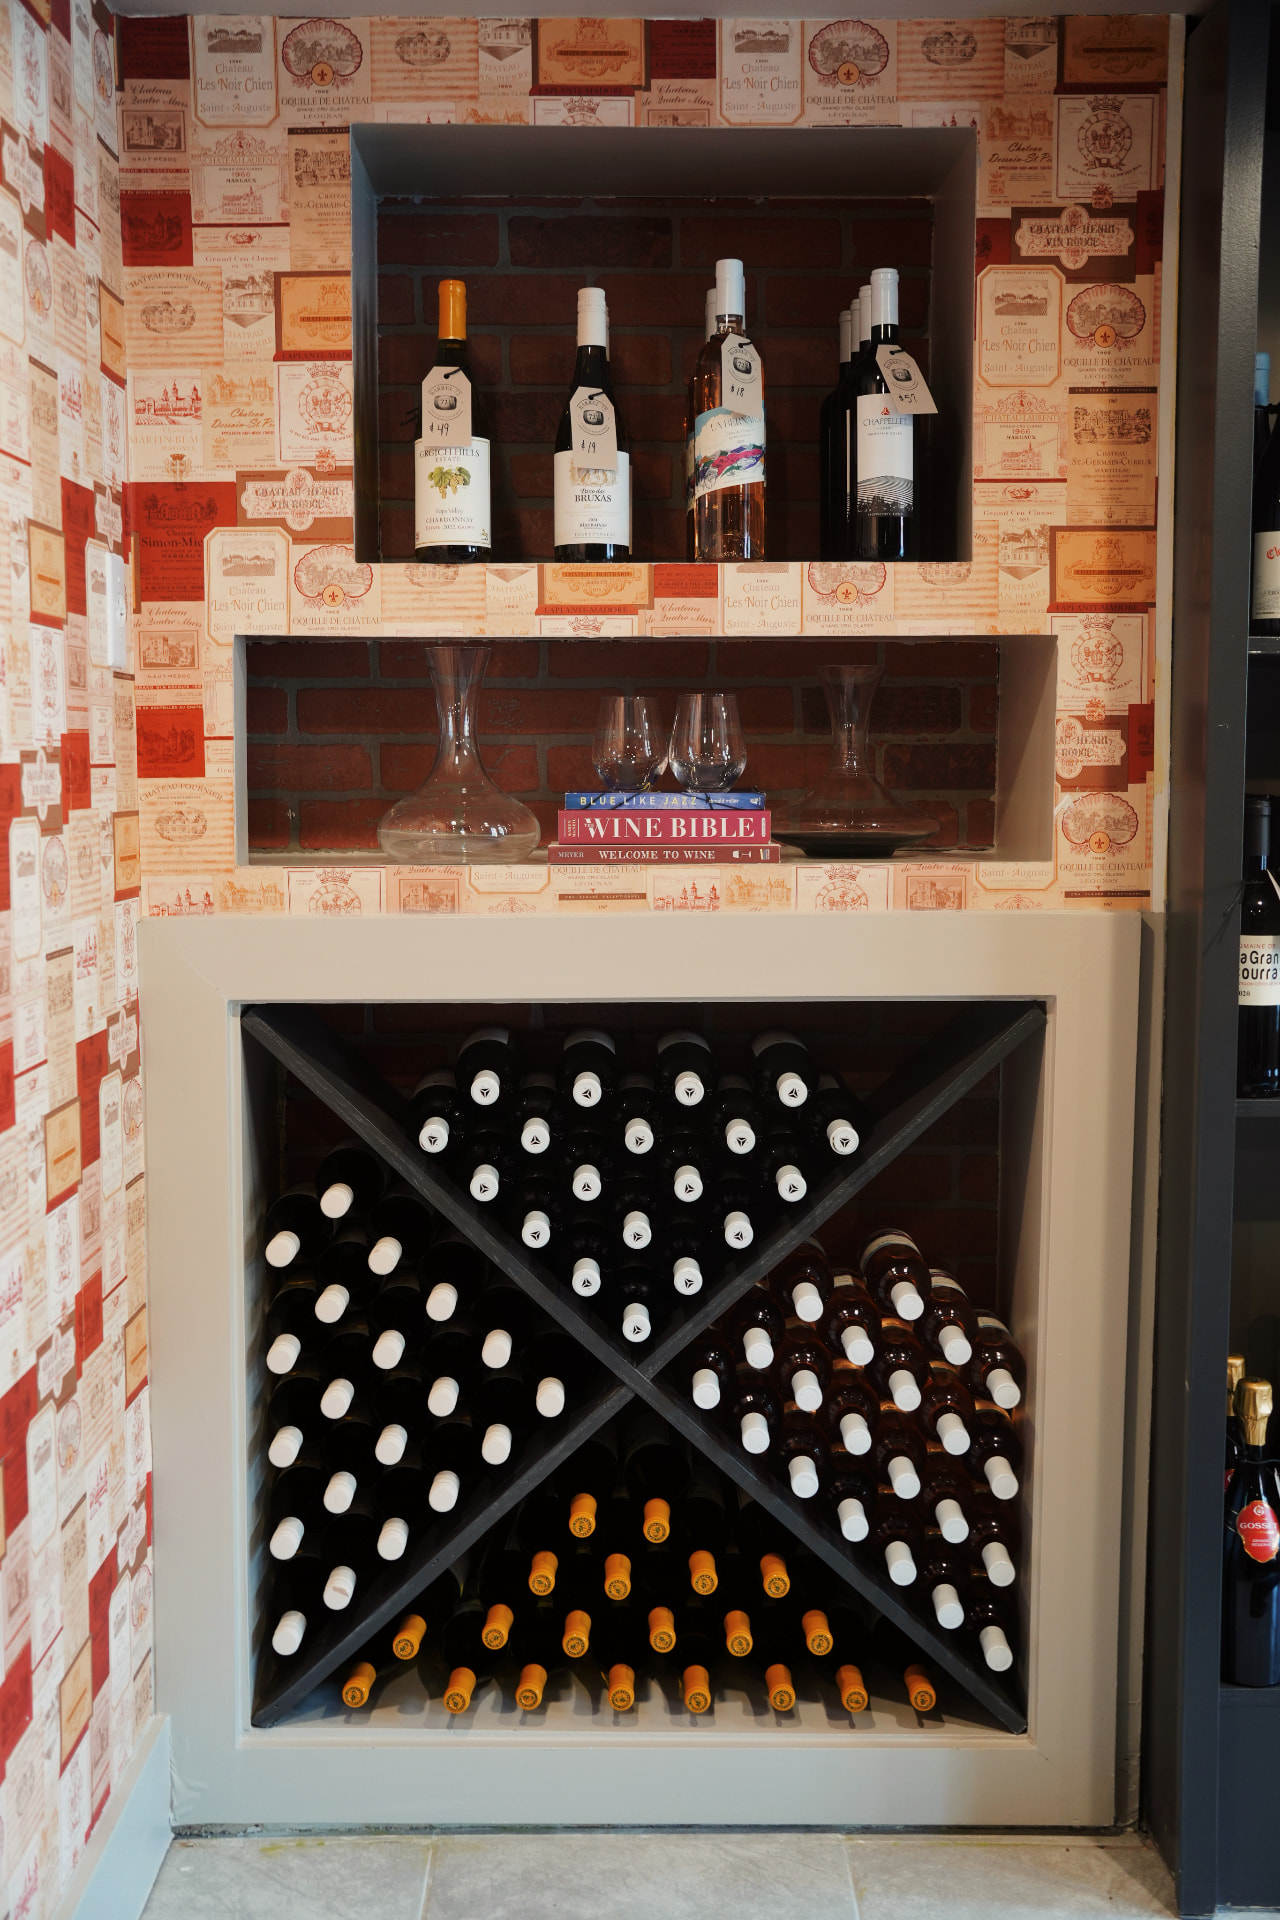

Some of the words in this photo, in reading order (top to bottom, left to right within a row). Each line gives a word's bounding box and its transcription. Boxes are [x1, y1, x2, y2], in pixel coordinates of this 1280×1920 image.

[198, 78, 216, 91] Les
[218, 78, 242, 91] Noir
[245, 78, 274, 94] Chien
[723, 78, 742, 90] Les
[744, 78, 768, 90] Noir
[770, 77, 799, 92] Chien
[982, 340, 1000, 351] Les
[1002, 340, 1027, 351] Noir
[1028, 339, 1056, 353] Chien
[454, 449, 480, 458] HILLS
[575, 494, 612, 503] BRUXAS
[211, 600, 229, 612] Les
[231, 600, 254, 612] Noir
[257, 599, 285, 614] Chien
[725, 597, 743, 608] Les
[745, 597, 768, 608] Noir
[771, 596, 799, 610] Chien
[580, 797, 616, 806] BLUE
[624, 797, 656, 805] LIKE
[664, 797, 697, 806] JAZZ
[584, 818, 662, 839] WINE
[670, 818, 756, 838] BIBLE
[599, 851, 658, 860] WELCOME
[663, 851, 680, 860] TO
[684, 851, 716, 860] WINE
[1239, 968, 1278, 980] ourra
